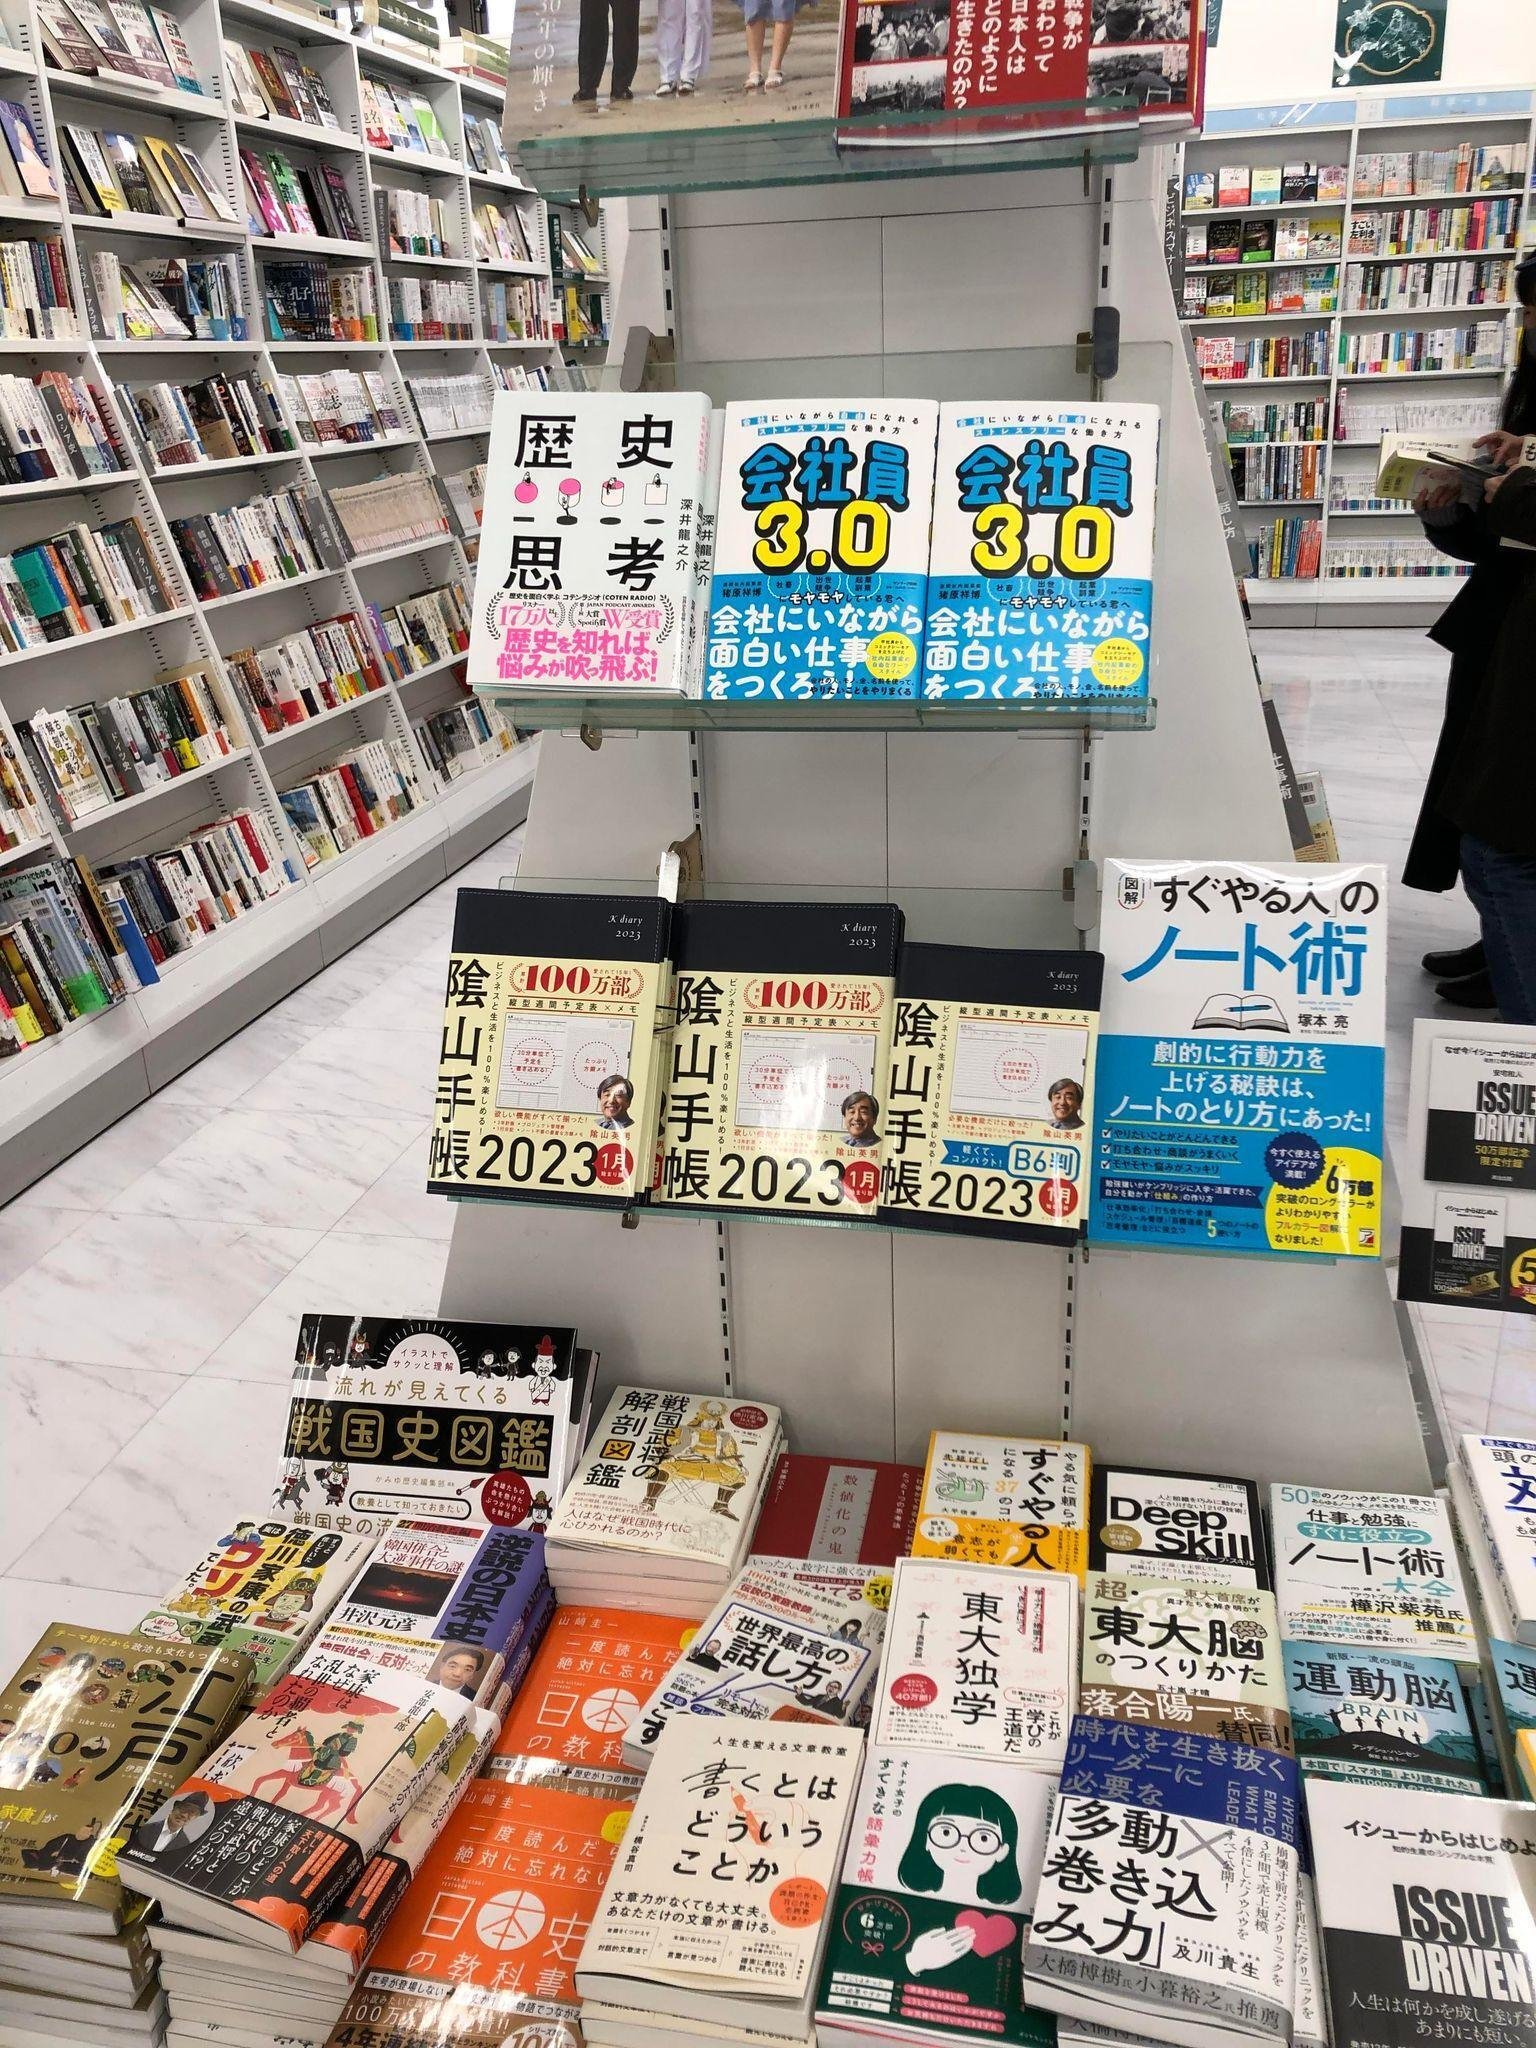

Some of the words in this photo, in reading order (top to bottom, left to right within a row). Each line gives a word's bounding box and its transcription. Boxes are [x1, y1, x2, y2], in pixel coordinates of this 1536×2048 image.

[1007, 0, 1029, 74] 日本人は
[952, 1, 975, 109] 生きたのか?
[513, 414, 674, 469] 歴史
[740, 437, 911, 511] 会社員
[956, 439, 1133, 517] 会社員
[675, 498, 693, 572] 深井龍之介
[697, 514, 715, 587] 深井龍之介
[753, 500, 891, 575] 3.0
[971, 504, 1114, 578] 3.0
[502, 535, 665, 591] 思考
[712, 603, 923, 634] 会社にいながら
[926, 607, 1149, 641] 会社にいながら
[504, 629, 658, 657] 歴史を知れば、
[709, 636, 870, 668] 面白い仕事
[926, 640, 1097, 674] 面白い仕事
[497, 654, 658, 681] 悩みが吹っ飛ぶ!
[1124, 876, 1139, 904] 図解
[616, 929, 641, 941] 2023
[620, 915, 643, 926] diary
[853, 922, 878, 934] diary
[849, 937, 877, 948] 2023
[1120, 921, 1367, 998] ノート術
[523, 965, 631, 996] 100万部
[760, 980, 872, 1013] 100万部
[1053, 983, 1078, 993] 2023
[1298, 1013, 1327, 1028] 塚本
[1334, 1014, 1349, 1029] 亮
[429, 959, 491, 1181] 陰山手帳
[1153, 1042, 1326, 1069] 劇的に行動力を
[662, 976, 724, 1200] 陰山手帳
[1161, 1072, 1317, 1099] 上げる秘訣は、
[882, 1002, 939, 1208] 陰山手帳
[1109, 1095, 1371, 1132] ノートのとり方にあった!
[962, 1144, 995, 1158] 軽くて、
[1043, 1130, 1082, 1140] 陰山英男
[476, 1134, 597, 1187] 2023
[835, 1147, 879, 1159] 陰山英男
[951, 1153, 1002, 1168] コンパクト!
[1270, 1148, 1320, 1159] 今すぐ使える
[1275, 1159, 1318, 1170] アイデアが
[718, 1154, 846, 1206] 2023
[849, 1172, 875, 1189] 1月
[928, 1172, 1032, 1217] 2023
[1275, 1234, 1323, 1246] なりました!
[1452, 1244, 1484, 1260] DRIVEN
[1453, 1226, 1486, 1244] ISSUE
[393, 1360, 454, 1372] サクッと理解
[401, 1348, 448, 1359] イラストで
[334, 1376, 507, 1405] 流れが見えてくる
[289, 1404, 548, 1472] 戦国史図鑑
[583, 1391, 660, 1488] 解剖図鑑
[632, 1395, 690, 1480] 戦国武将の
[356, 1496, 464, 1513] 教養として知っておきたい
[485, 1497, 524, 1513] ぶつかり合い
[828, 1474, 858, 1555] 数値化の鬼
[1111, 1496, 1227, 1535] Deep
[1307, 1509, 1418, 1528] 仕事と勉強に
[560, 1520, 662, 1541] 心ひかれるのか?
[564, 1510, 690, 1534] 人はなぜ戦国時代に
[1308, 1525, 1425, 1542] すぐに役立つ
[377, 1552, 464, 1573] 大逆事件の謎
[384, 1539, 449, 1557] 韓国併合と
[1155, 1528, 1254, 1563] Skill
[185, 1553, 220, 1588] でした。
[192, 1542, 265, 1596] ウソ
[439, 1532, 534, 1646] 逆説の日本史
[1382, 1576, 1455, 1597] 大全
[339, 1606, 417, 1632] 井沢元彦
[1351, 1599, 1464, 1621] 樺沢紫苑氏
[738, 1616, 850, 1665] 世界最高の
[1089, 1606, 1267, 1660] 東大脳
[722, 1636, 831, 1690] 話し方
[951, 1593, 1004, 1725] 東大独学
[1096, 1653, 1267, 1686] のつくりかた
[1326, 1653, 1415, 1671] 新版・一流の頭脳
[1293, 1660, 1457, 1713] 運動脳
[394, 1689, 435, 1732] 安部龍太郎
[1082, 1689, 1263, 1723] 落合陽一氏、
[1344, 1703, 1418, 1723] BRAIN
[1004, 1707, 1023, 1753] 王道だ
[1027, 1710, 1046, 1747] 学びの
[1048, 1711, 1060, 1740] これが
[1217, 1720, 1291, 1750] 賛同!
[713, 1738, 848, 1756] 人生を変える文章教室
[1070, 1742, 1204, 1786] リーダーに
[1074, 1719, 1285, 1782] 時代を生き抜く
[682, 1758, 838, 1800] 書くとは
[1063, 1771, 1163, 1807] 必要な
[206, 1804, 266, 1874] 戦国武将と
[234, 1812, 281, 1864] 同時代の
[687, 1810, 823, 1848] どういう
[229, 1818, 302, 1895] 家康のどこが
[624, 1836, 643, 1872] 梶谷真司
[673, 1849, 779, 1884] ことか
[857, 1817, 884, 1884] 語彙力帳
[1042, 1846, 1217, 1922] 巻き込
[607, 1906, 777, 1935] あなただけの文章が書ける。
[611, 1891, 768, 1919] 文章力がなくても大丈夫。
[1392, 1883, 1519, 1950] ISSUE
[422, 1888, 589, 1962] 日本史
[1034, 1901, 1165, 1969] み力」
[598, 1944, 648, 1955] 対話的文章法で
[667, 1951, 718, 1964] 言葉が見つかる
[1173, 1943, 1259, 1980] 及川貴生
[407, 1951, 569, 1998] の教科書
[739, 1965, 786, 1976] 読んでもらえる
[1401, 1940, 1533, 2004] DRIVEN
[1416, 2020, 1527, 2048] あまりにも短い。
